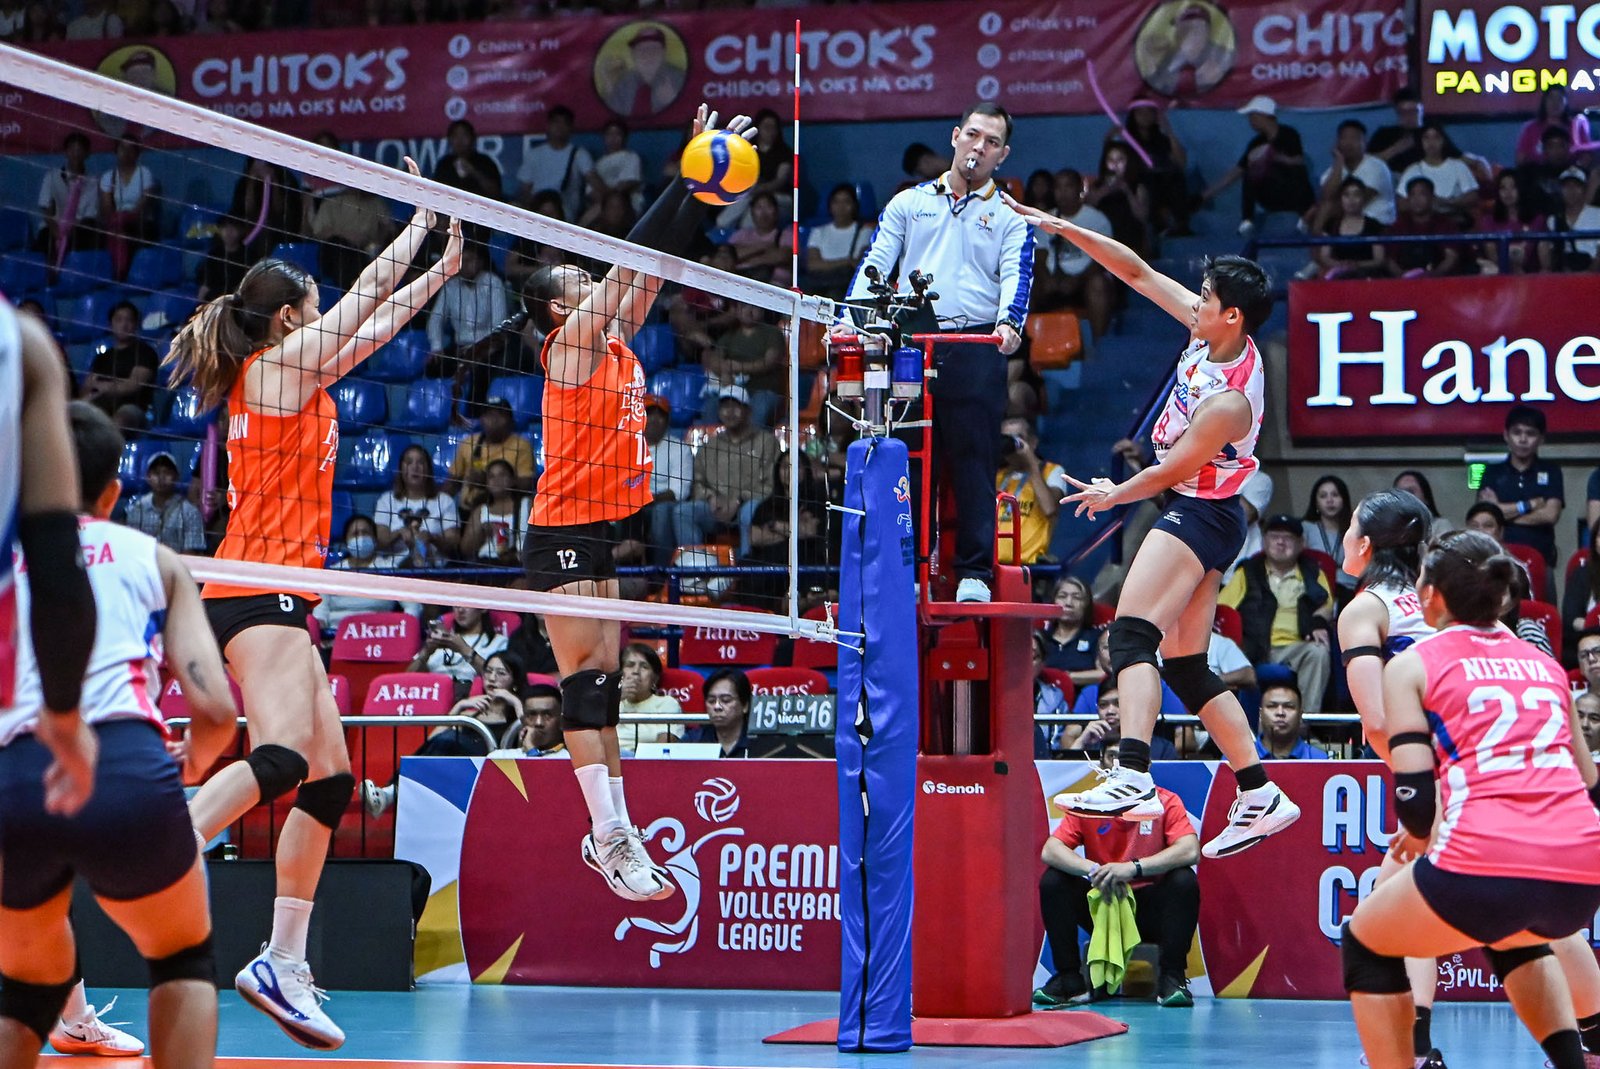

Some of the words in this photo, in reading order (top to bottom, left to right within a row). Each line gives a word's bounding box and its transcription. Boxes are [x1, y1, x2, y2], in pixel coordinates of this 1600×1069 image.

[703, 24, 937, 75] CHITOK'S
[192, 47, 409, 97] CHITOK'S
[1338, 60, 1369, 78] NA
[703, 79, 780, 98] CHIBOG
[863, 75, 890, 92] NA
[269, 101, 294, 117] NA
[340, 98, 366, 114] NA
[1305, 309, 1600, 407] Hane
[557, 548, 578, 570] 12
[278, 594, 294, 612] 5
[343, 620, 407, 640] Akari
[365, 644, 382, 658] 16
[718, 645, 736, 659] 10
[1459, 657, 1555, 683] NIERVA
[374, 682, 440, 703] Akari
[396, 704, 413, 716] 15
[753, 701, 777, 728] 15
[808, 701, 832, 728] 16
[1466, 685, 1575, 775] 22
[936, 783, 985, 795] Senoh
[719, 843, 838, 889] PREMI
[718, 922, 803, 951] LEAGUE
